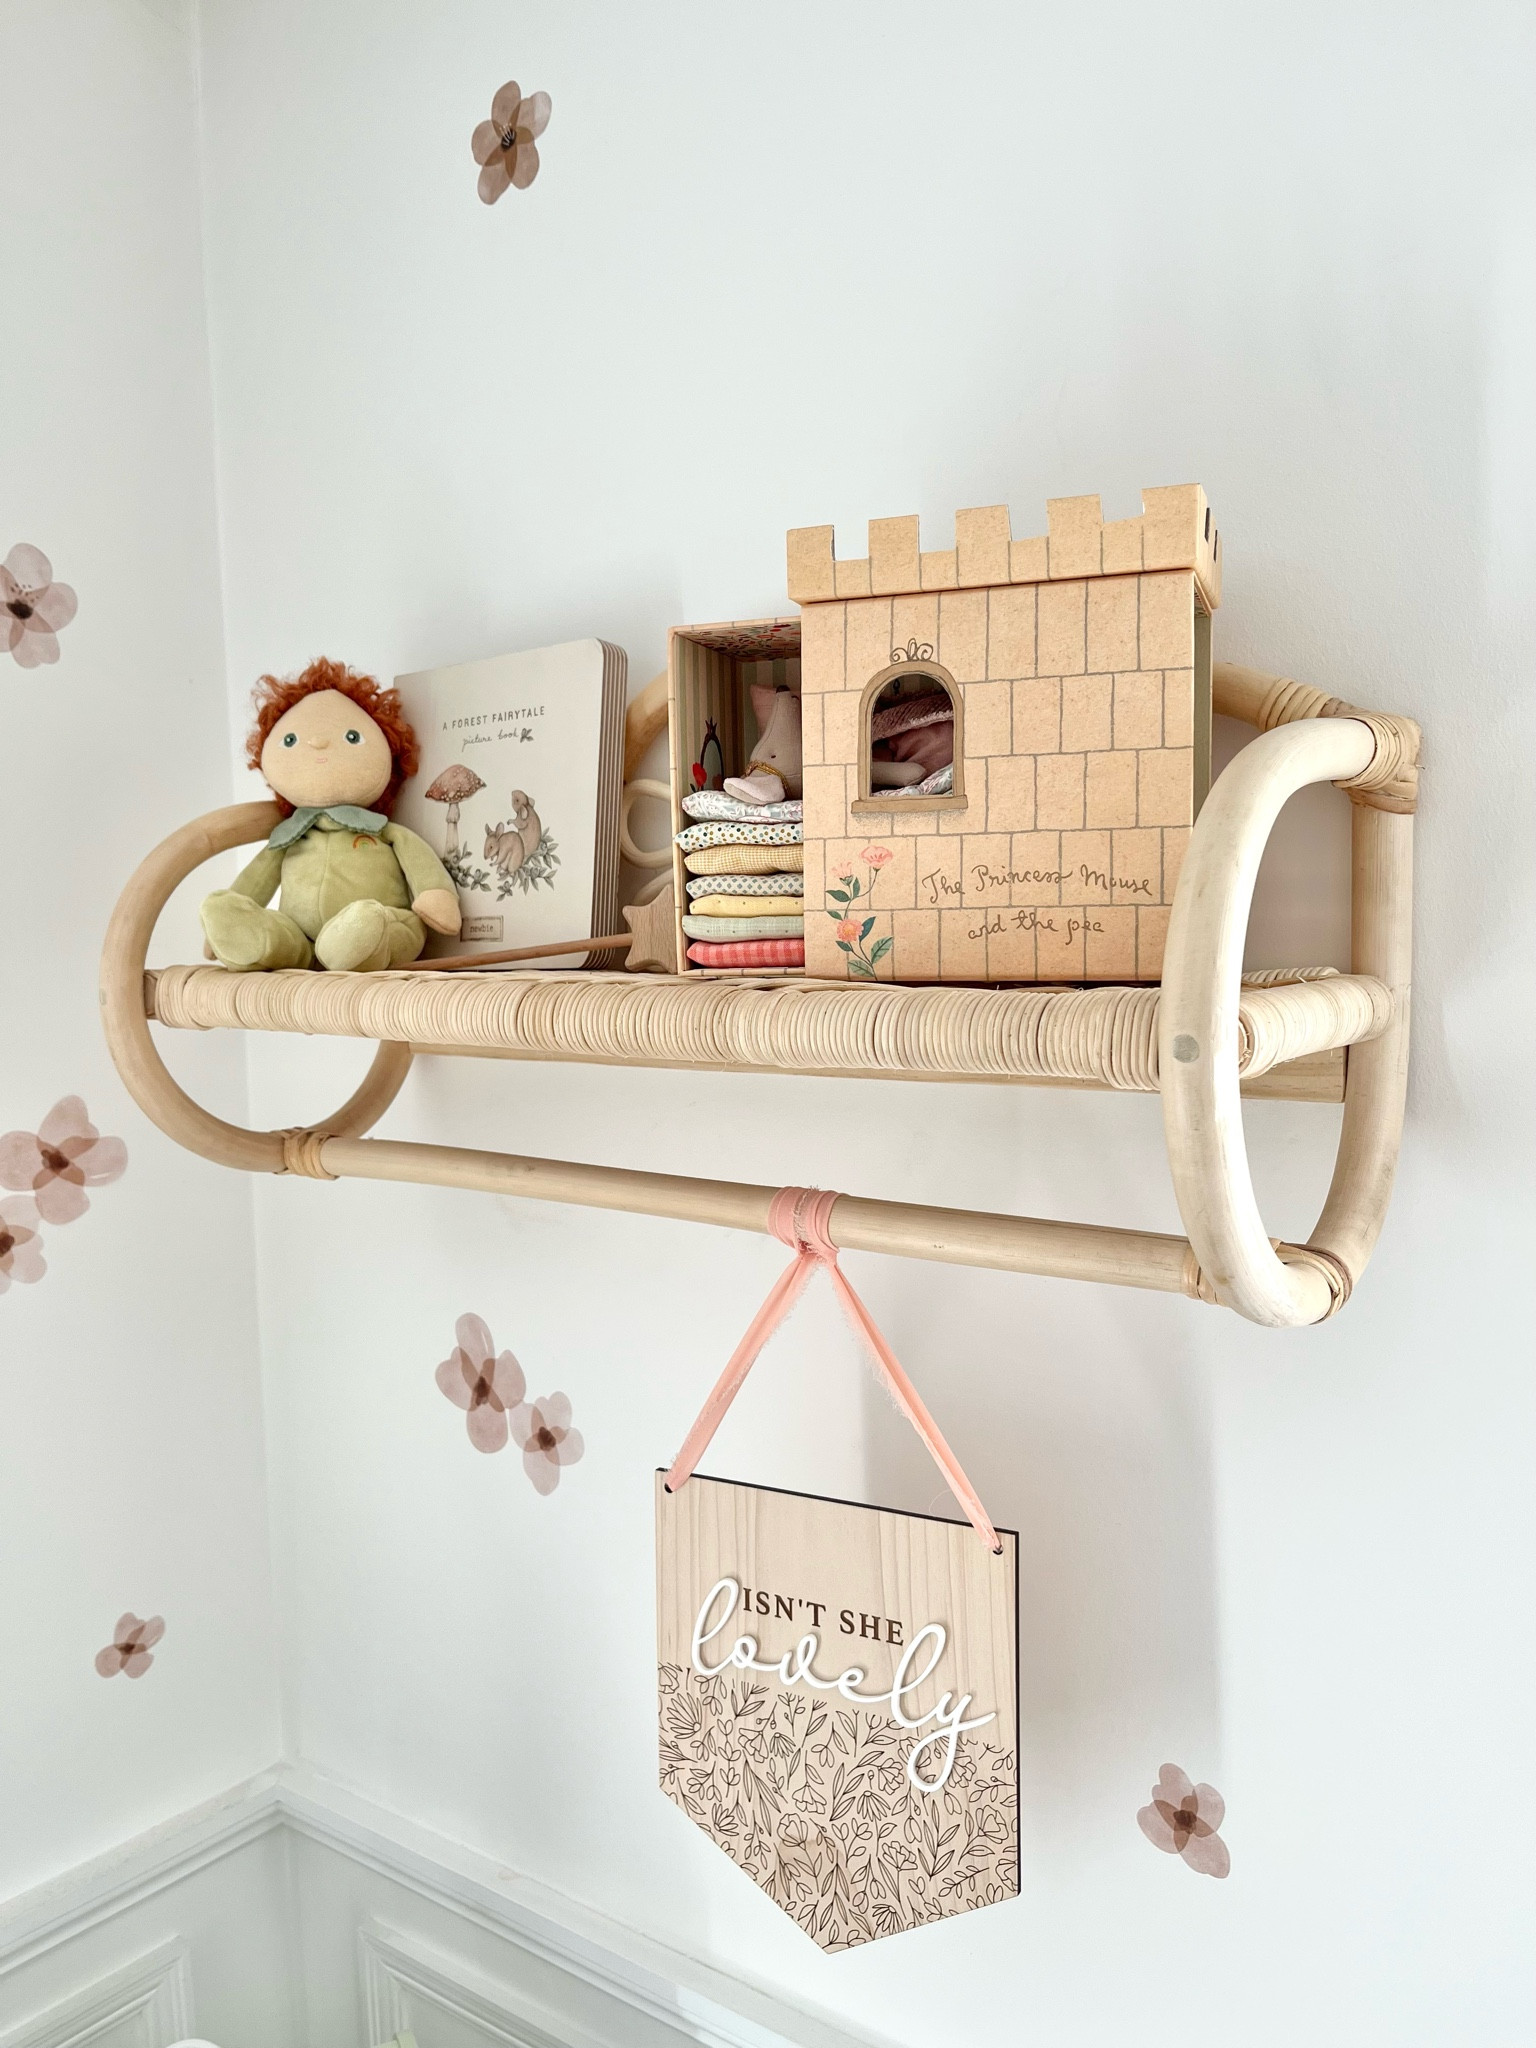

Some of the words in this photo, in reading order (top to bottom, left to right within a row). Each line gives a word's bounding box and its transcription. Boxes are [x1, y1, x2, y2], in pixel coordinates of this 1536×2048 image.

[442, 721, 448, 732] A
[451, 714, 488, 729] FOREST
[492, 705, 545, 723] FAIRYTALE
[461, 733, 493, 753] picture
[497, 728, 520, 741] book
[922, 868, 966, 904] The
[971, 864, 1073, 892] Princess
[1080, 864, 1153, 896] Mouse
[968, 914, 1007, 940] and
[1011, 910, 1059, 932] the
[1064, 918, 1105, 946] pea
[742, 1587, 827, 1629] ISN'T
[839, 1609, 905, 1647] SHE
[691, 1576, 998, 1793] lovely
